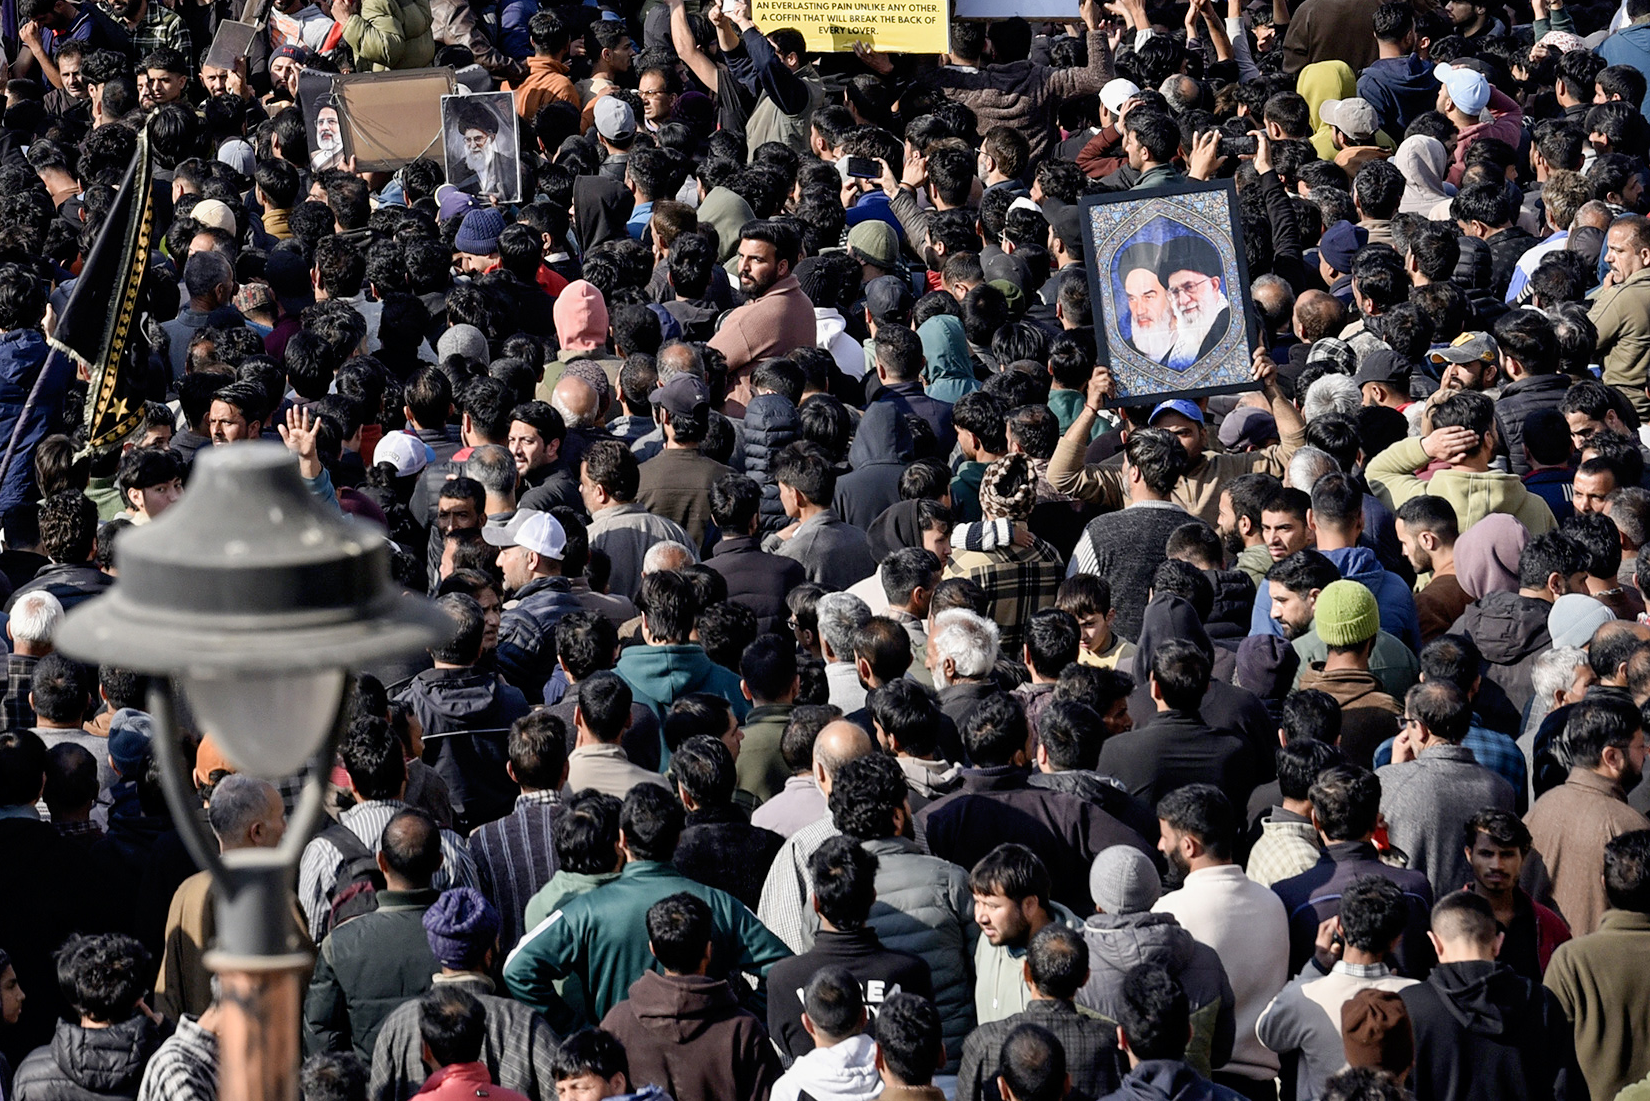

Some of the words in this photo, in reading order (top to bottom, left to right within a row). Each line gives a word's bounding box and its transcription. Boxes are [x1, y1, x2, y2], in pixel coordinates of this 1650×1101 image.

[772, 2, 829, 10] EVERLASTING
[855, 3, 885, 11] UNLIKE
[909, 4, 939, 12] OTHER.
[803, 14, 825, 22] THAT
[850, 15, 878, 23] BREAK
[898, 16, 922, 24] BACK
[819, 26, 845, 34] EVERY
[848, 27, 879, 35] LOVER.
